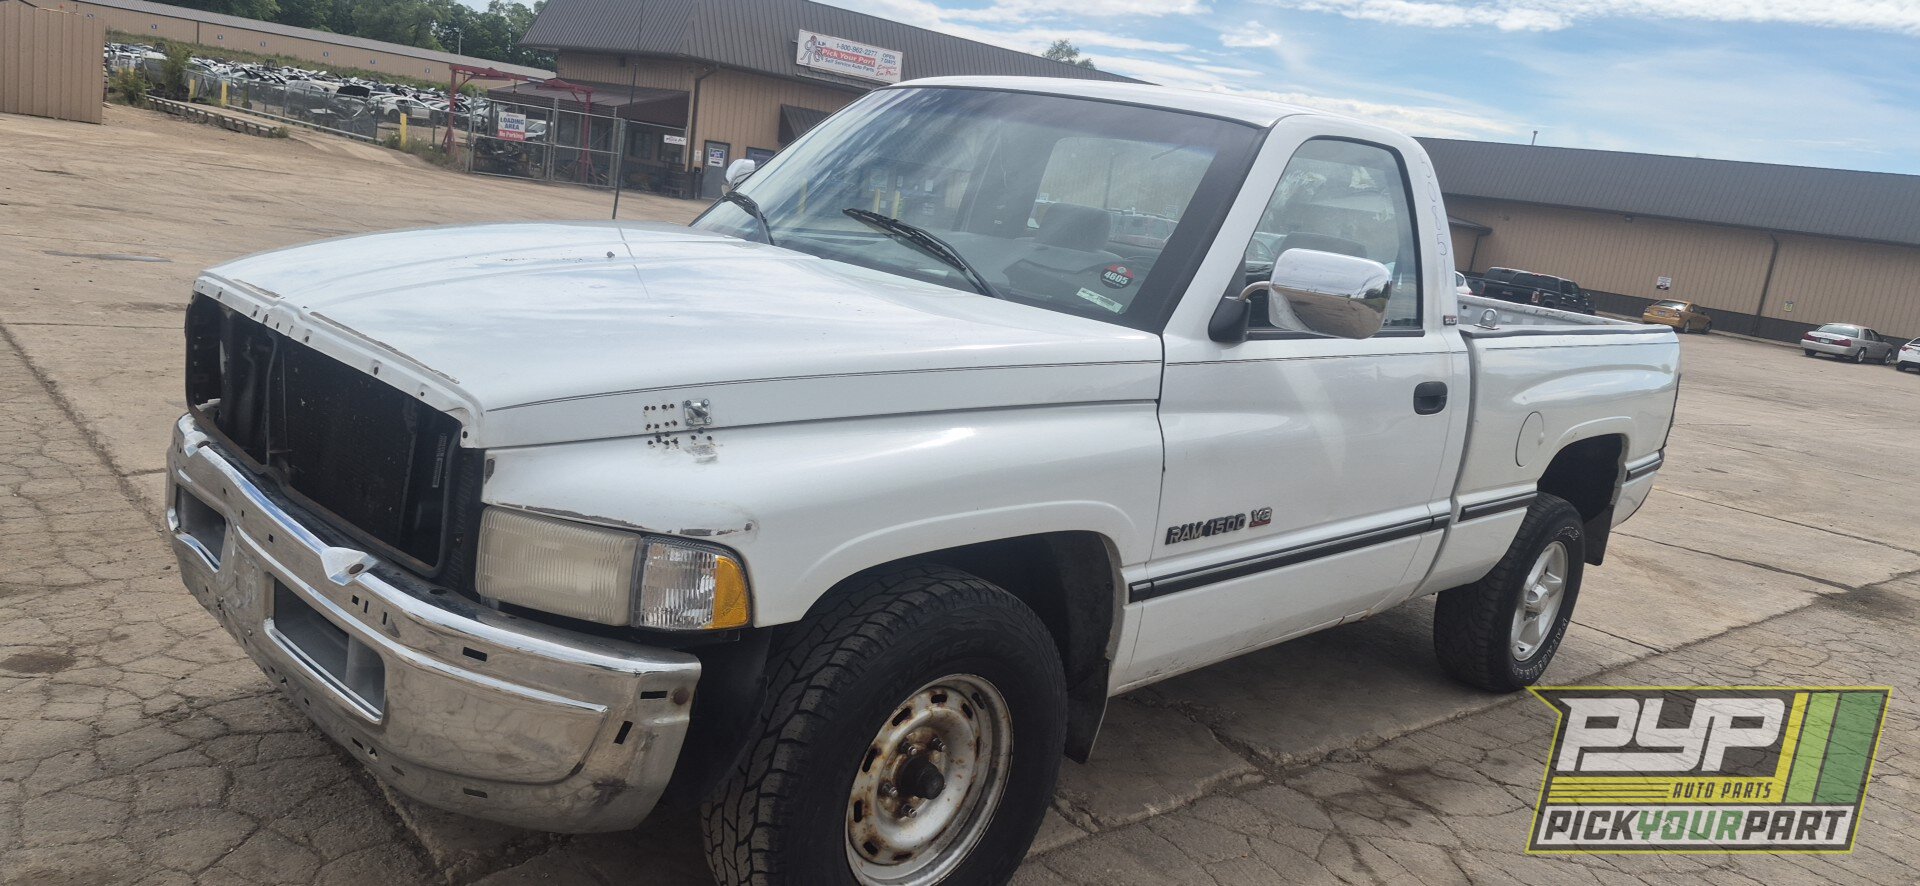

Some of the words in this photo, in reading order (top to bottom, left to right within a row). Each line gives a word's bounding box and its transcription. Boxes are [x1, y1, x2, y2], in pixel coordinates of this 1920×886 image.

[822, 48, 838, 58] Pick
[840, 52, 857, 61] Your
[858, 57, 875, 65] Part
[500, 117, 524, 125] LOADING
[1104, 270, 1129, 285] 4605
[1165, 522, 1203, 545] RAM
[1203, 513, 1247, 537] 1500
